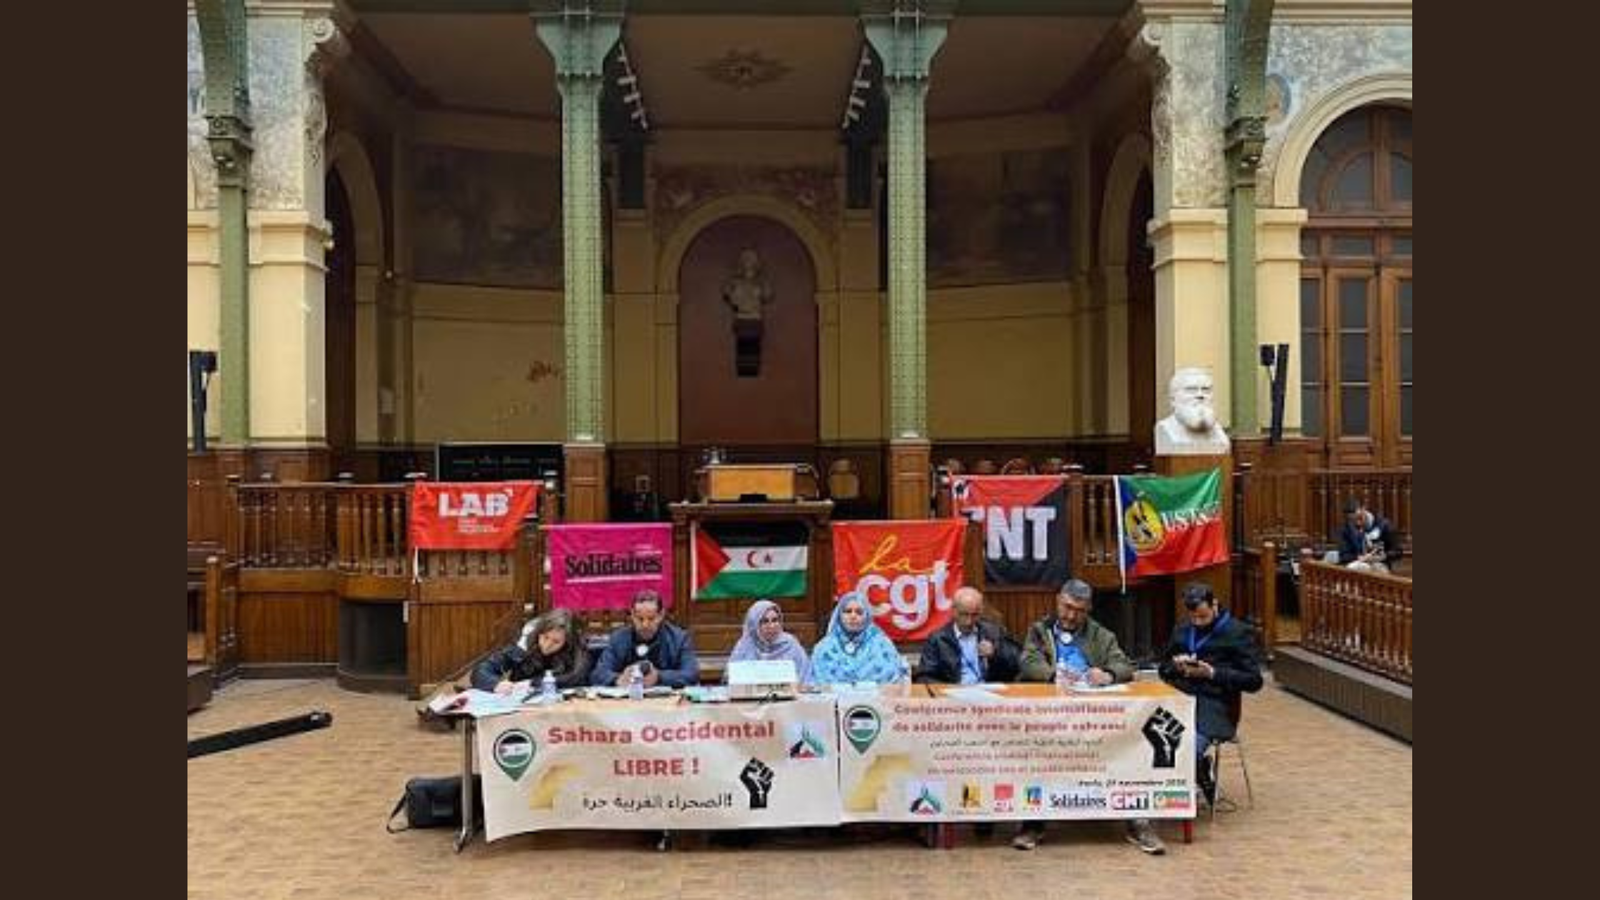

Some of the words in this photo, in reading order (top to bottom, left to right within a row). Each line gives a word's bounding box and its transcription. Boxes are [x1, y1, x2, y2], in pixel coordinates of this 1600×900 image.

[439, 492, 510, 517] LAB
[961, 505, 1057, 561] NT
[565, 553, 662, 578] Solidaires
[859, 534, 934, 574] la
[856, 558, 953, 631] cgt
[549, 726, 632, 744] Sahara
[641, 721, 774, 742] Occidental
[613, 758, 684, 776] LIBRE
[1049, 793, 1107, 810] Solidaires
